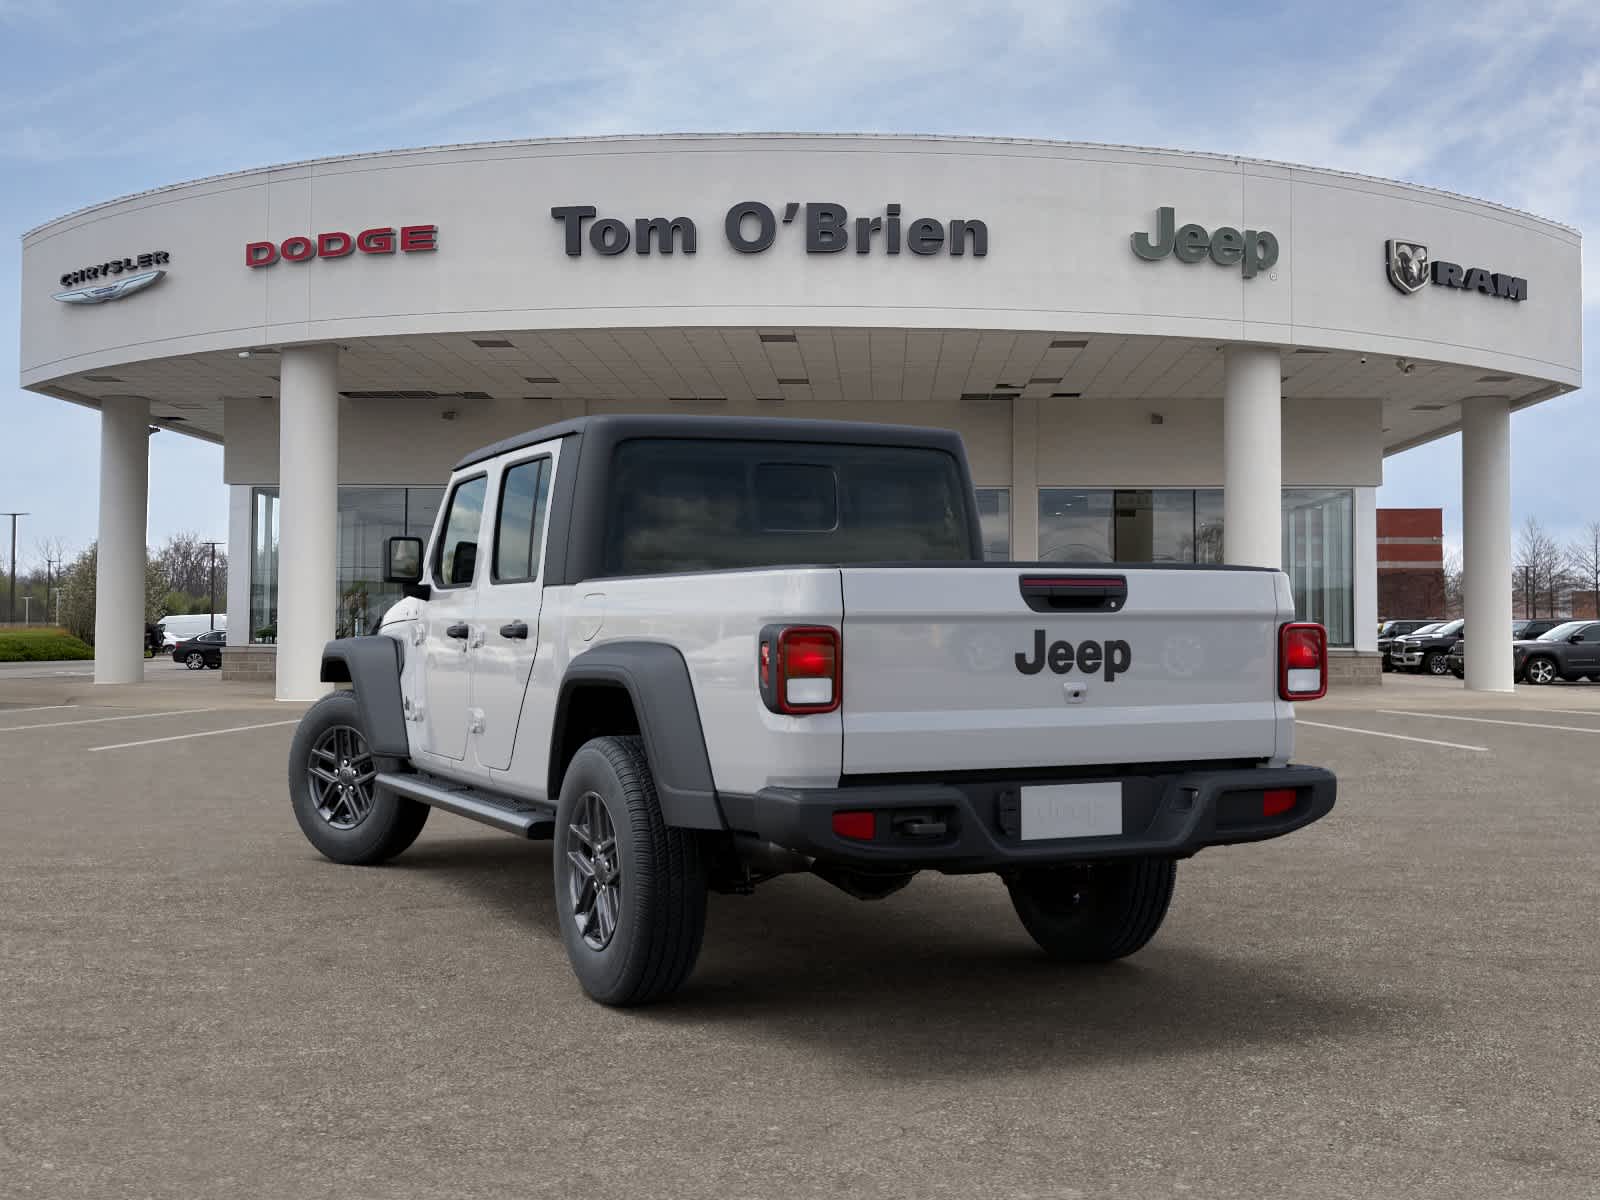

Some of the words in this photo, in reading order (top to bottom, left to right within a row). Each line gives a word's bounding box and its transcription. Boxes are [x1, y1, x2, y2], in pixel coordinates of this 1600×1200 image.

[245, 224, 438, 269] DODGE
[551, 205, 697, 256] Tom
[725, 201, 989, 256] O'Brien
[1130, 206, 1279, 279] Jeep
[60, 250, 170, 287] CHRYSLER
[1430, 260, 1528, 302] RAM
[1014, 628, 1132, 682] Jeep
